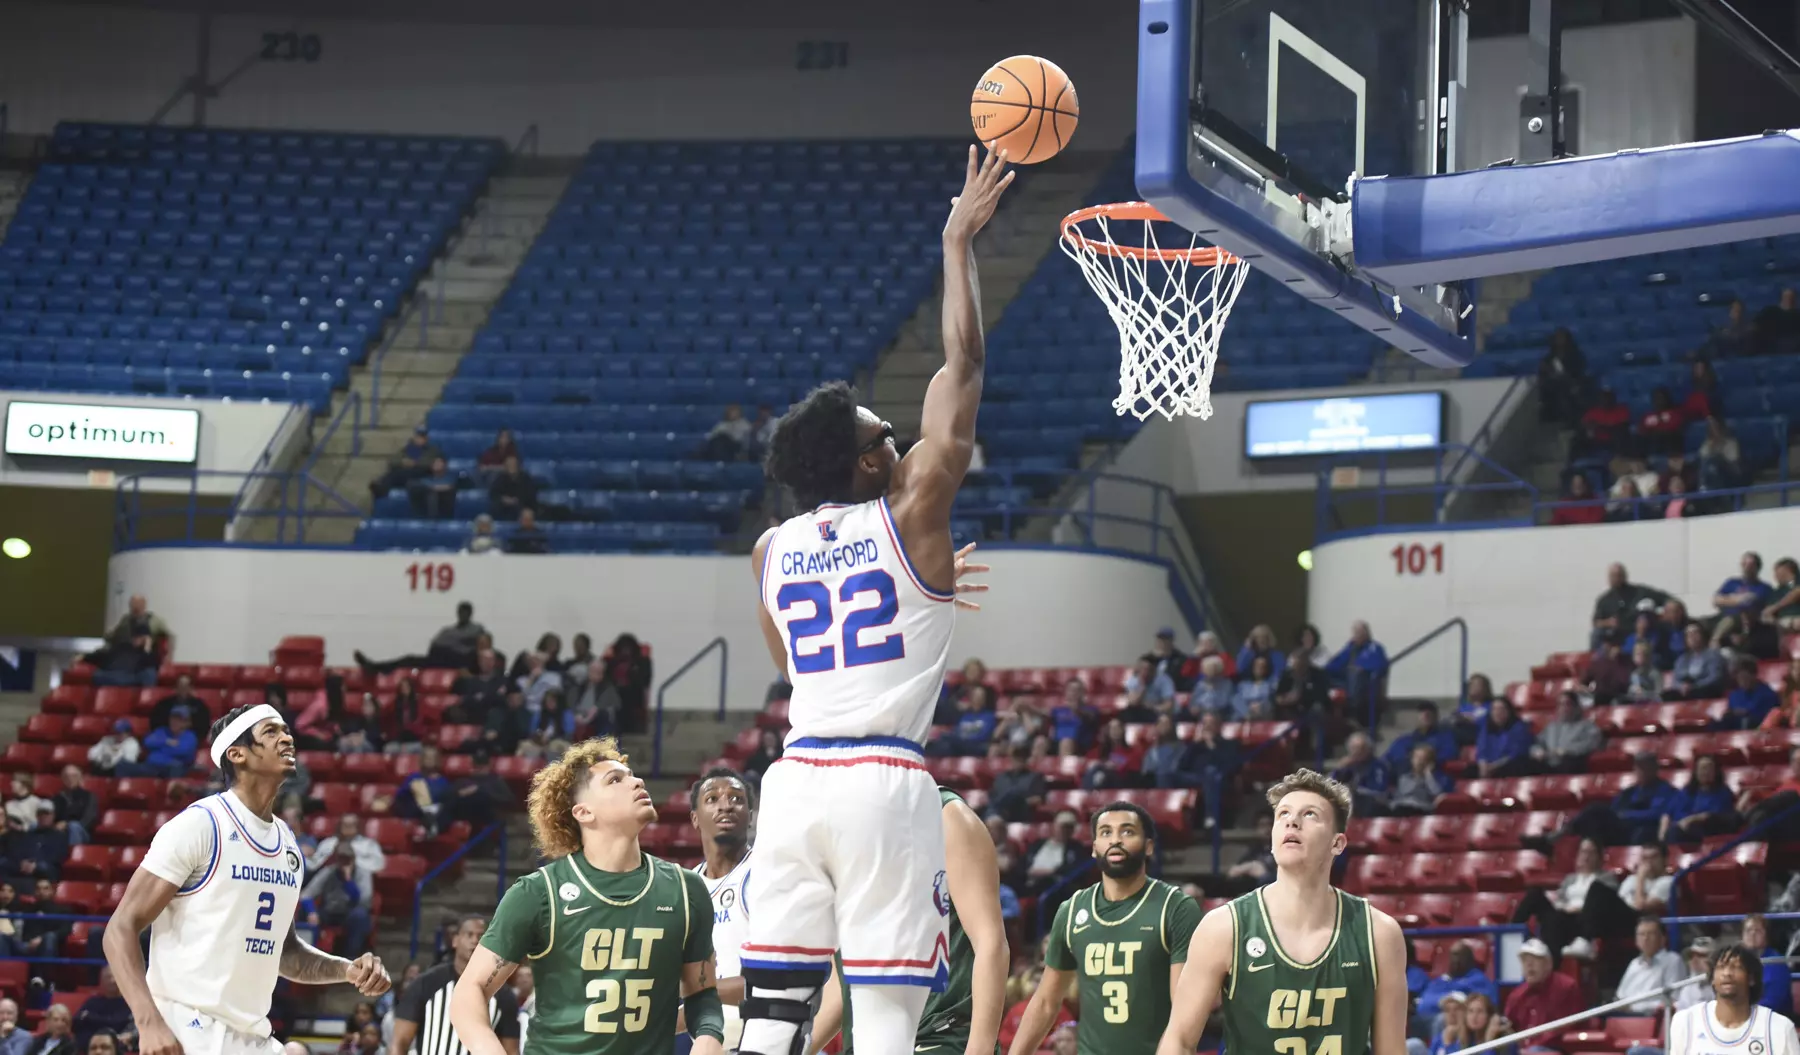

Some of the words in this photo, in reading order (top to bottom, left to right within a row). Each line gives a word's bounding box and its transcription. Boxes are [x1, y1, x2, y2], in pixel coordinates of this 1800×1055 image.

[781, 538, 879, 576] CRAWFORD
[1391, 543, 1443, 575] 101
[405, 562, 455, 592] 119
[776, 568, 905, 674] 22
[231, 864, 298, 888] LOUISIANA
[254, 891, 276, 931] 2
[245, 937, 276, 955] TECH
[580, 927, 665, 971] CLT
[1084, 941, 1143, 976] CLT
[584, 978, 655, 1034] 25
[1101, 981, 1129, 1024] 3
[1266, 986, 1348, 1029] CLT
